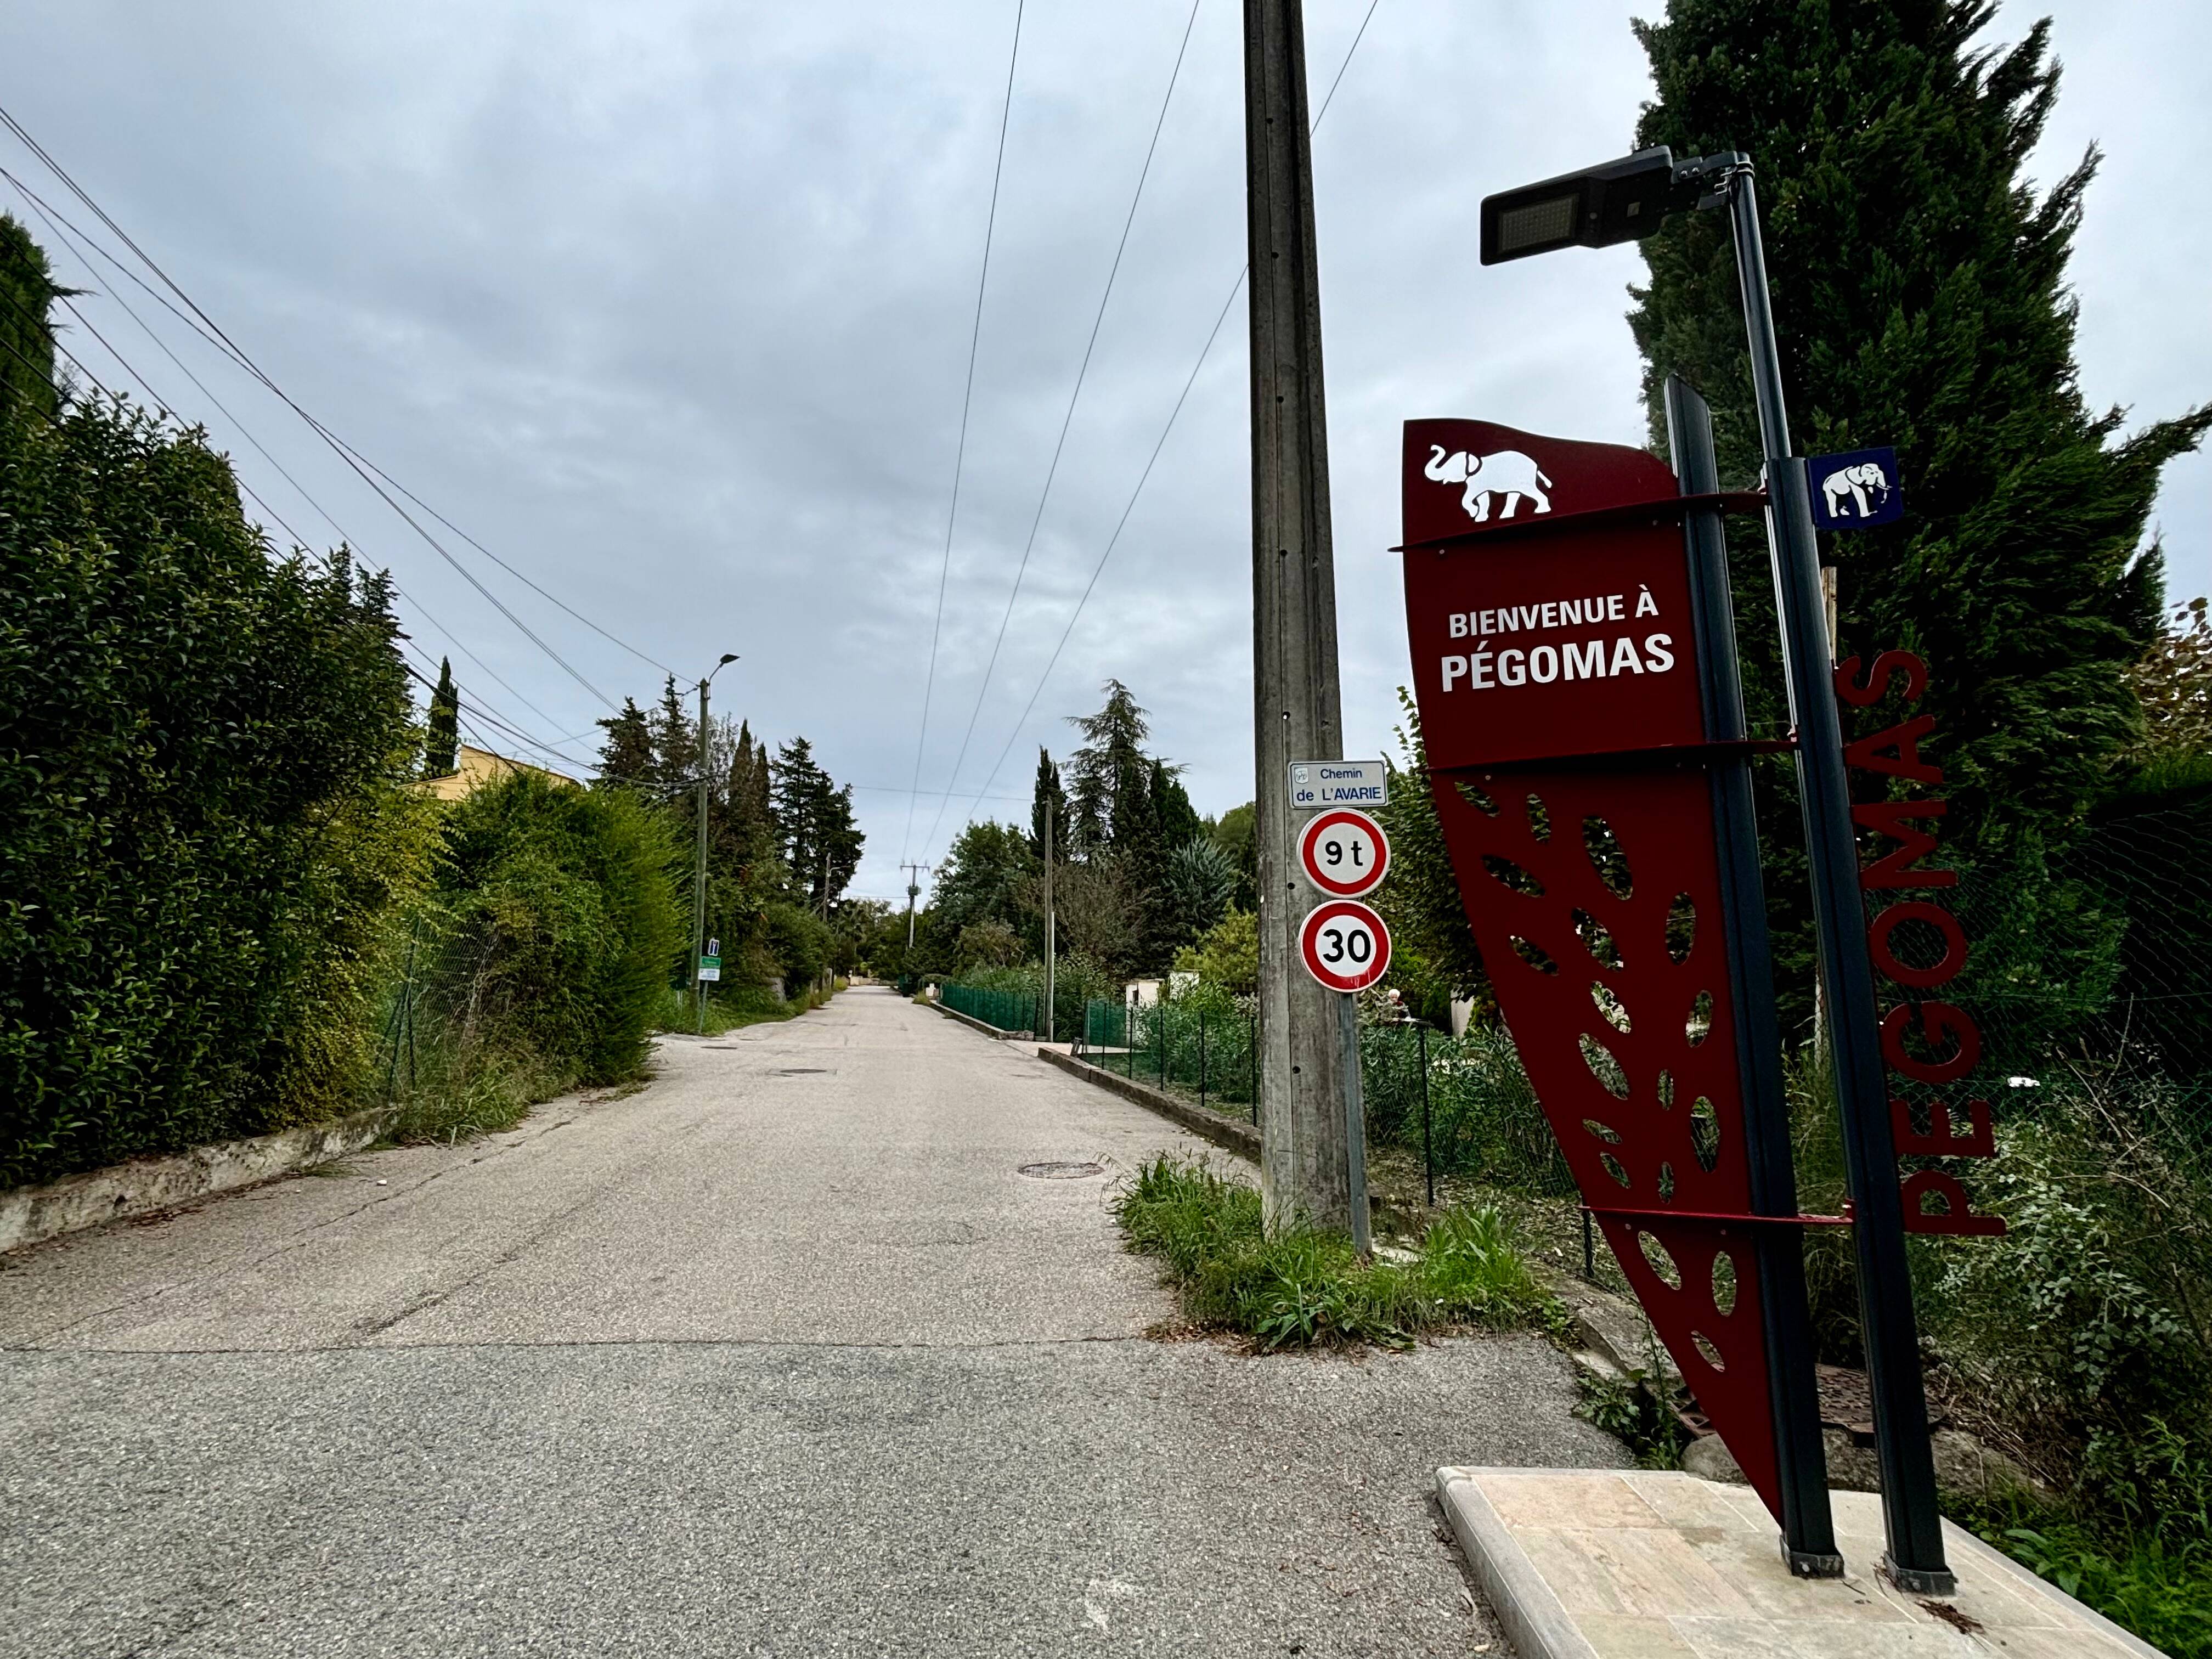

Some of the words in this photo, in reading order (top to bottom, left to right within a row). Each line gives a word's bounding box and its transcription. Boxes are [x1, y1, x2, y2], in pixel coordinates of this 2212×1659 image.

[1449, 594, 1624, 639] BIENVENUE
[1635, 584, 1659, 618] À
[1441, 633, 1674, 692] PÉGOMAS
[1320, 768, 1363, 779] Chemin
[1296, 789, 1314, 802] de
[1322, 786, 1383, 801] L'AVARIE
[1325, 840, 1342, 866] 9
[1350, 840, 1363, 866] t
[1323, 928, 1371, 963] 30
